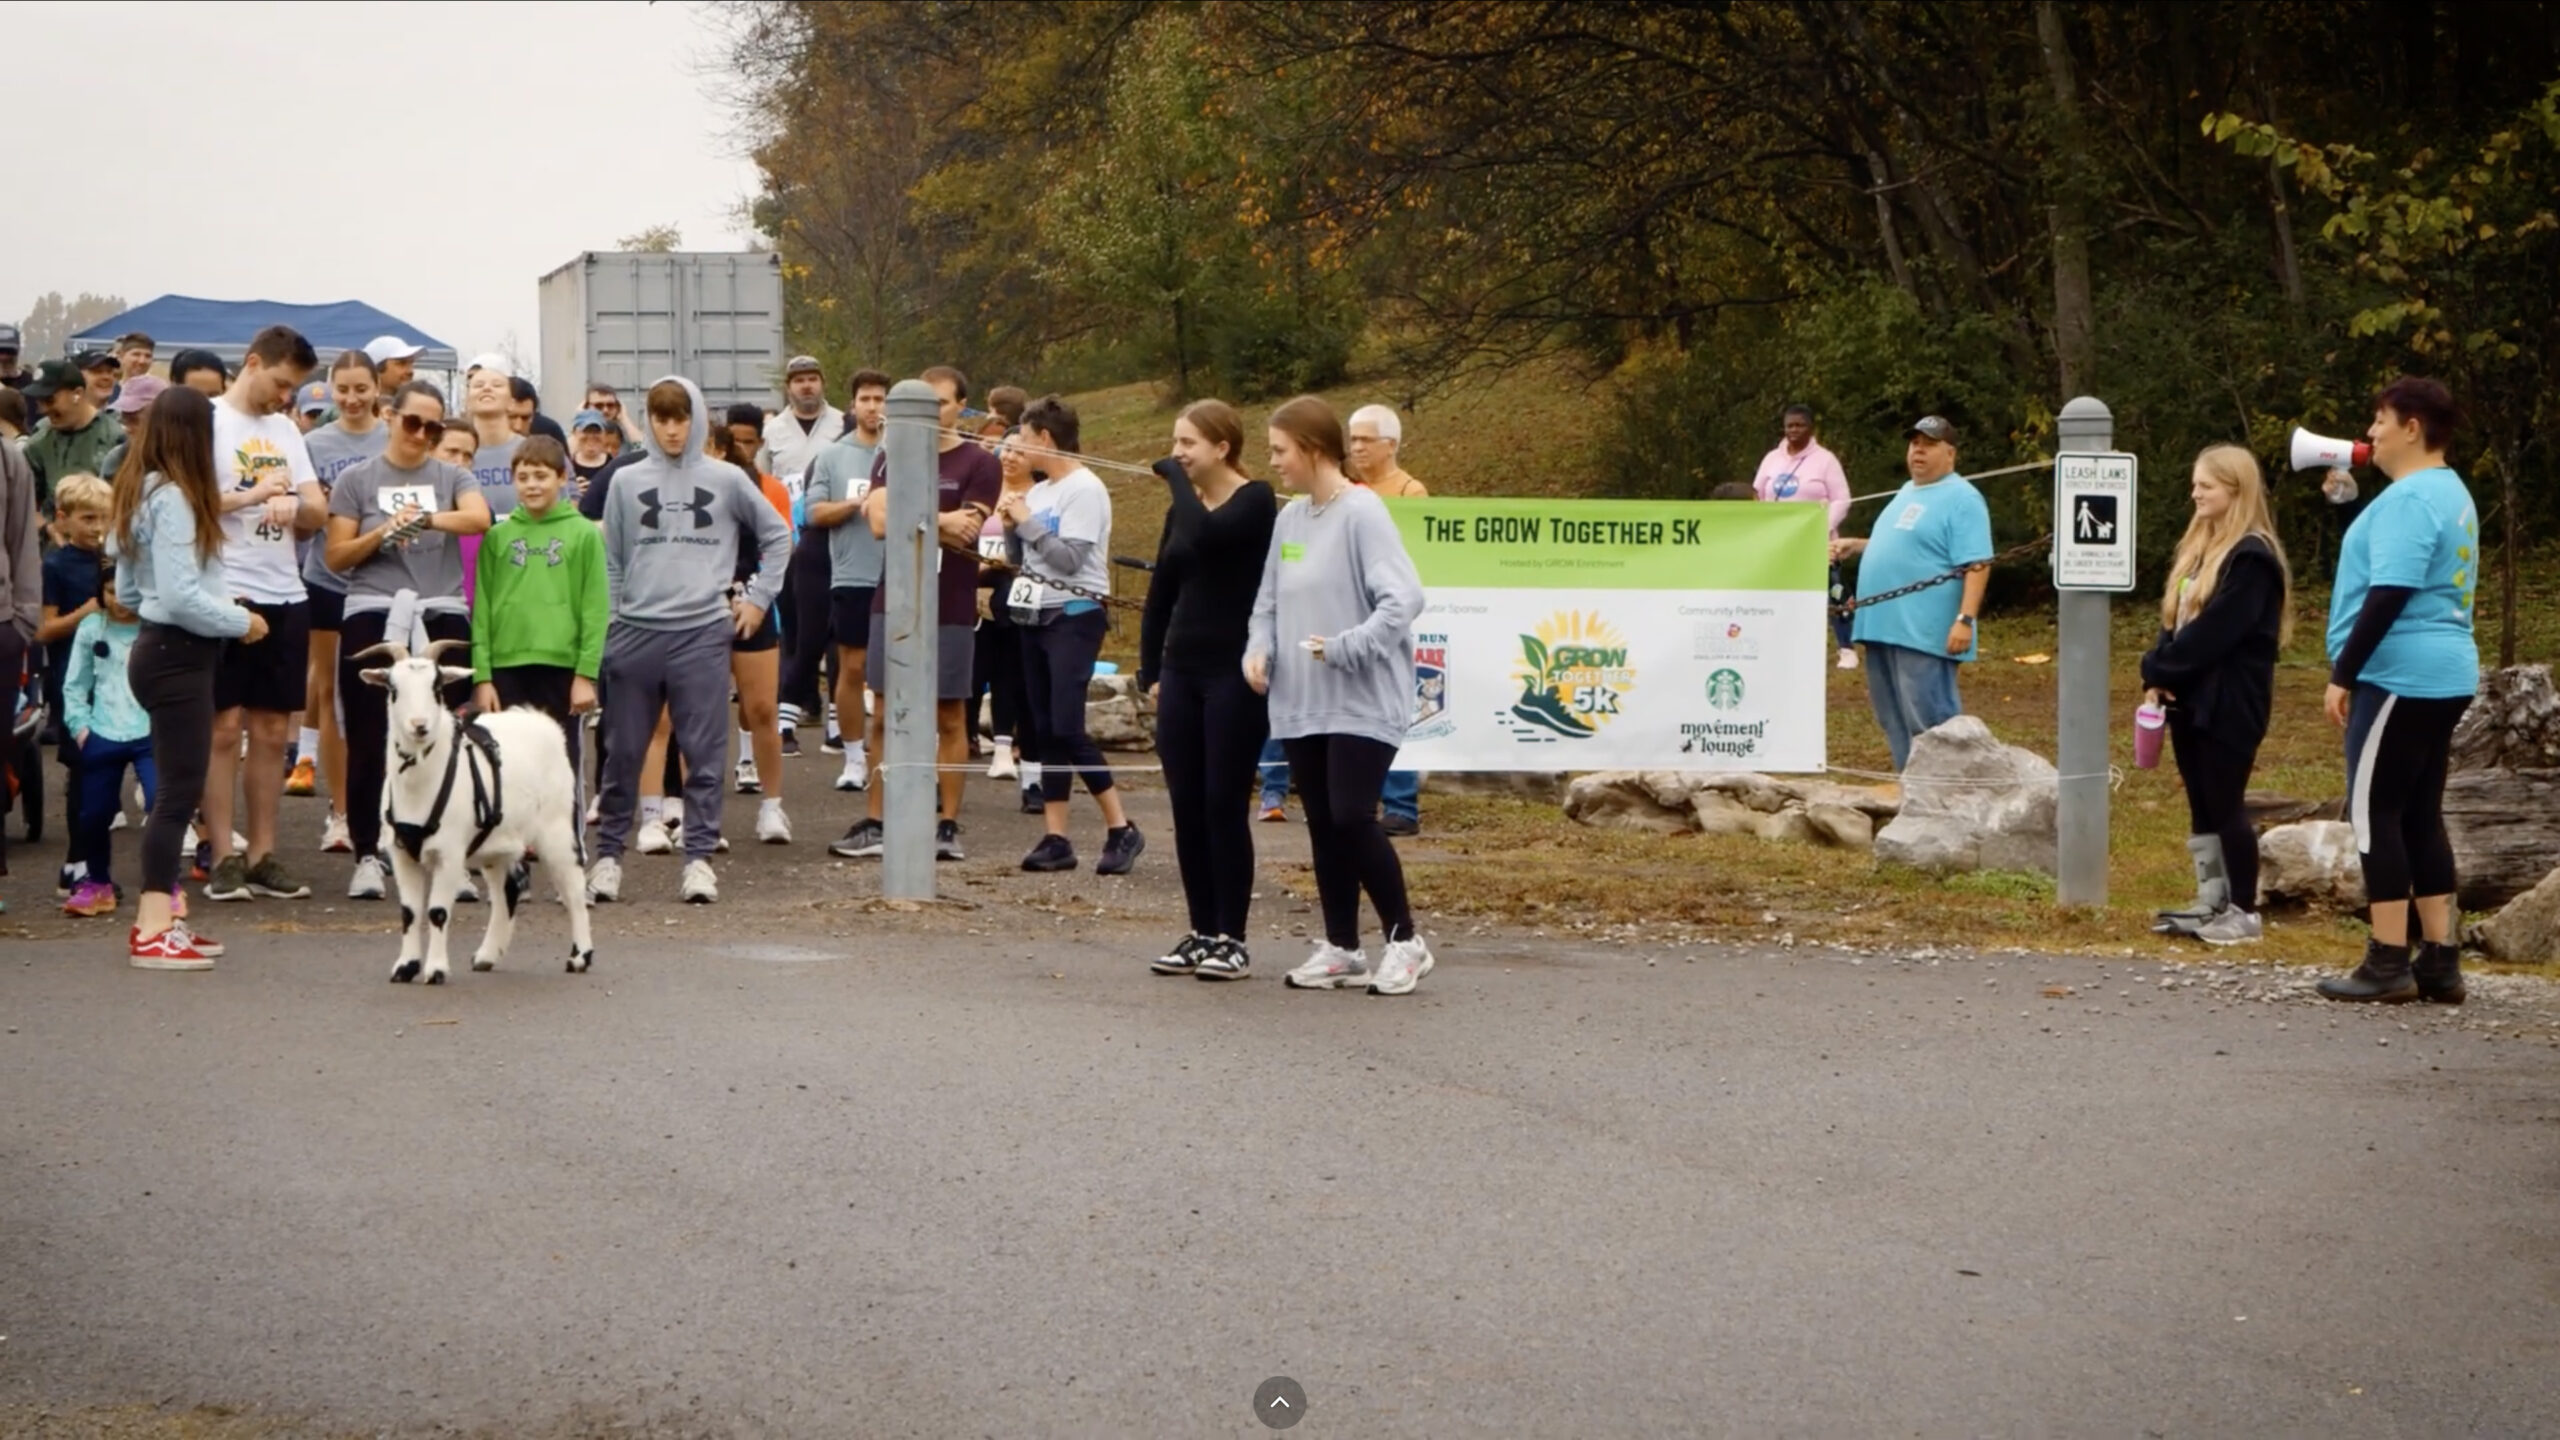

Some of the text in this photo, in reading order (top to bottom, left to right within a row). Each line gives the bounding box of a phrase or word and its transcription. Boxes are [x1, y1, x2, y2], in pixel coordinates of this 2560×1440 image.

[2065, 466, 2127, 480] LEASH LAWS
[255, 522, 283, 542] 49
[1475, 517, 1540, 543] GROW
[1672, 519, 1701, 545] 5K
[1500, 558, 1625, 570] Hosted by GROW Enrichment
[1447, 602, 1489, 615] Sponsor
[1678, 606, 1775, 617] Community Partners
[1418, 633, 1449, 643] RUN
[1554, 647, 1627, 669] GROW
